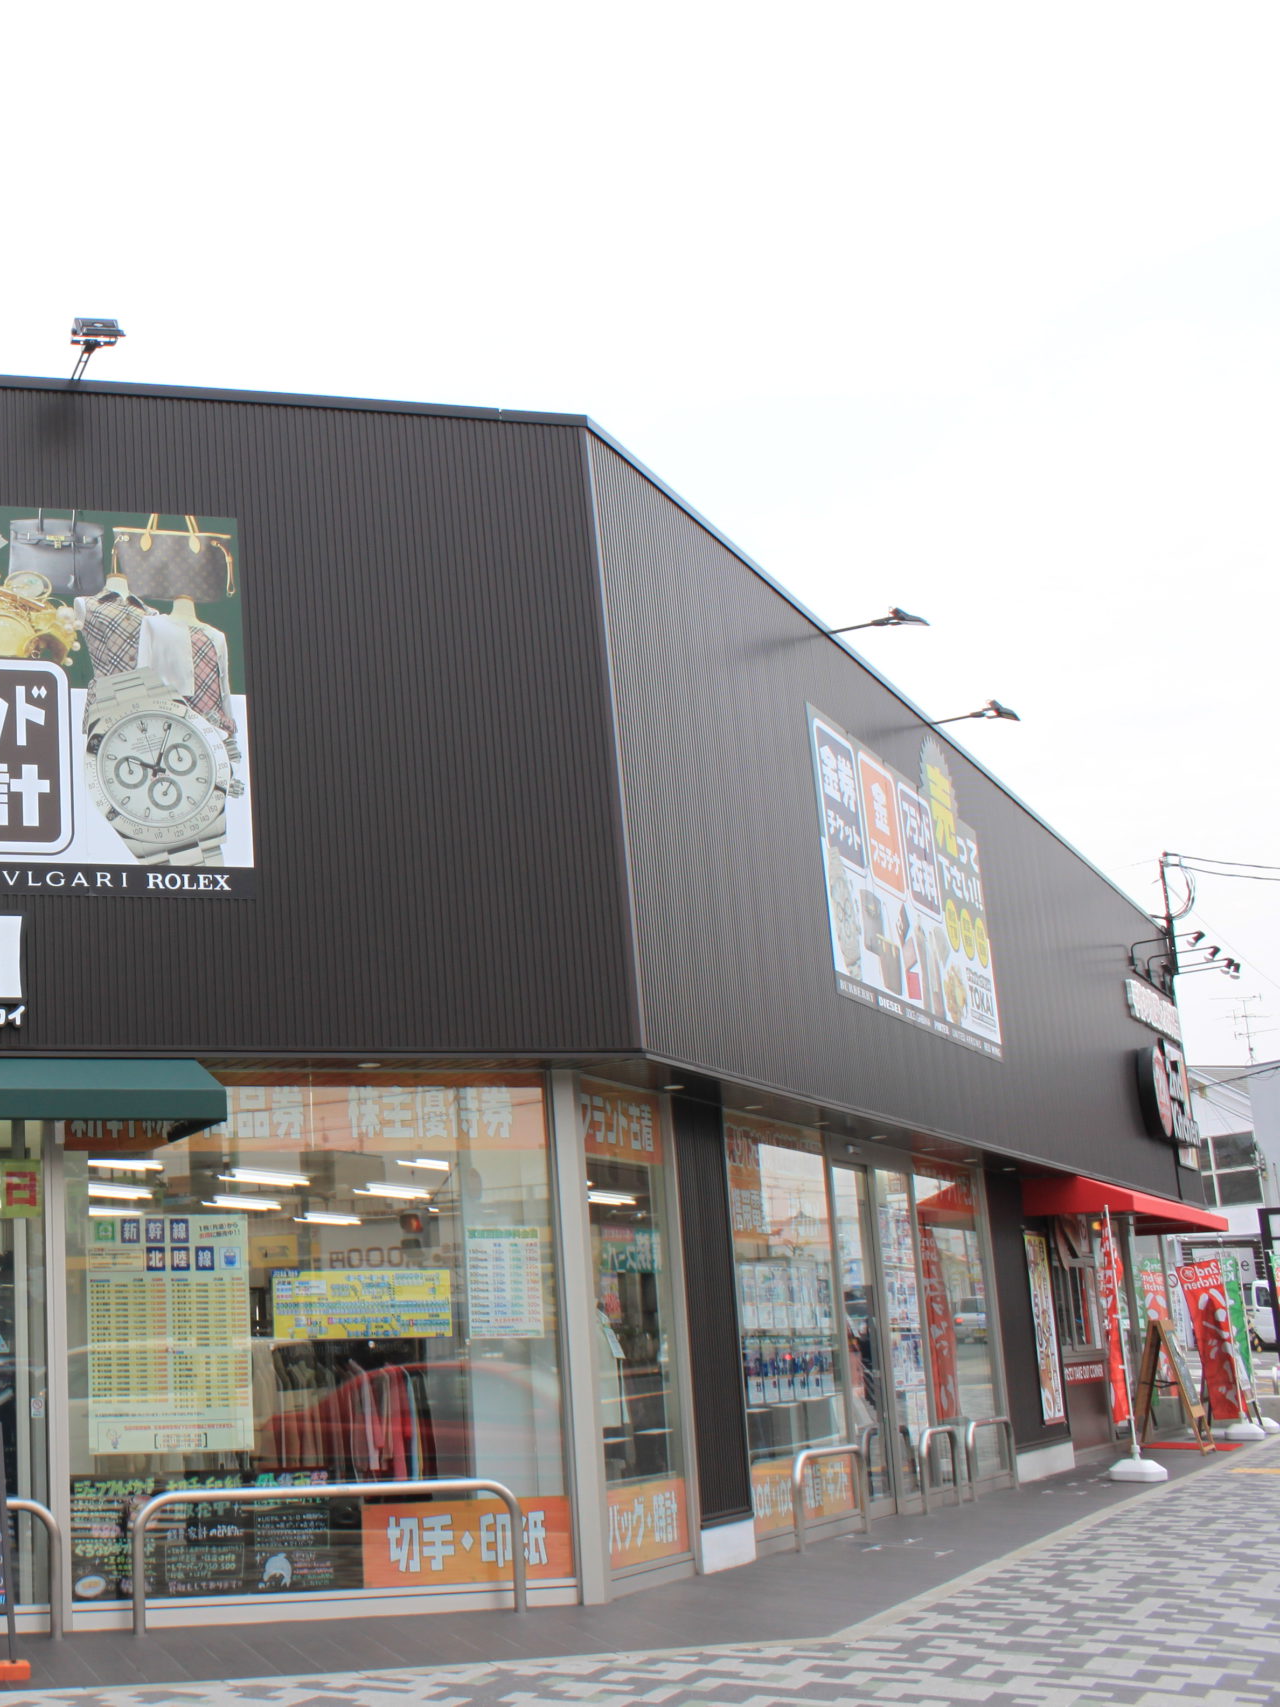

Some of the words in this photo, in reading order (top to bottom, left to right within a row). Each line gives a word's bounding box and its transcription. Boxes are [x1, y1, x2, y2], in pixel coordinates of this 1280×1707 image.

[820, 745, 856, 814] 金券
[870, 782, 890, 835] 金
[146, 872, 232, 891] ROLEX
[878, 995, 903, 1015] DIESEL
[348, 1086, 513, 1139] 株主優待券
[387, 1510, 547, 1573] 切手・印紙
